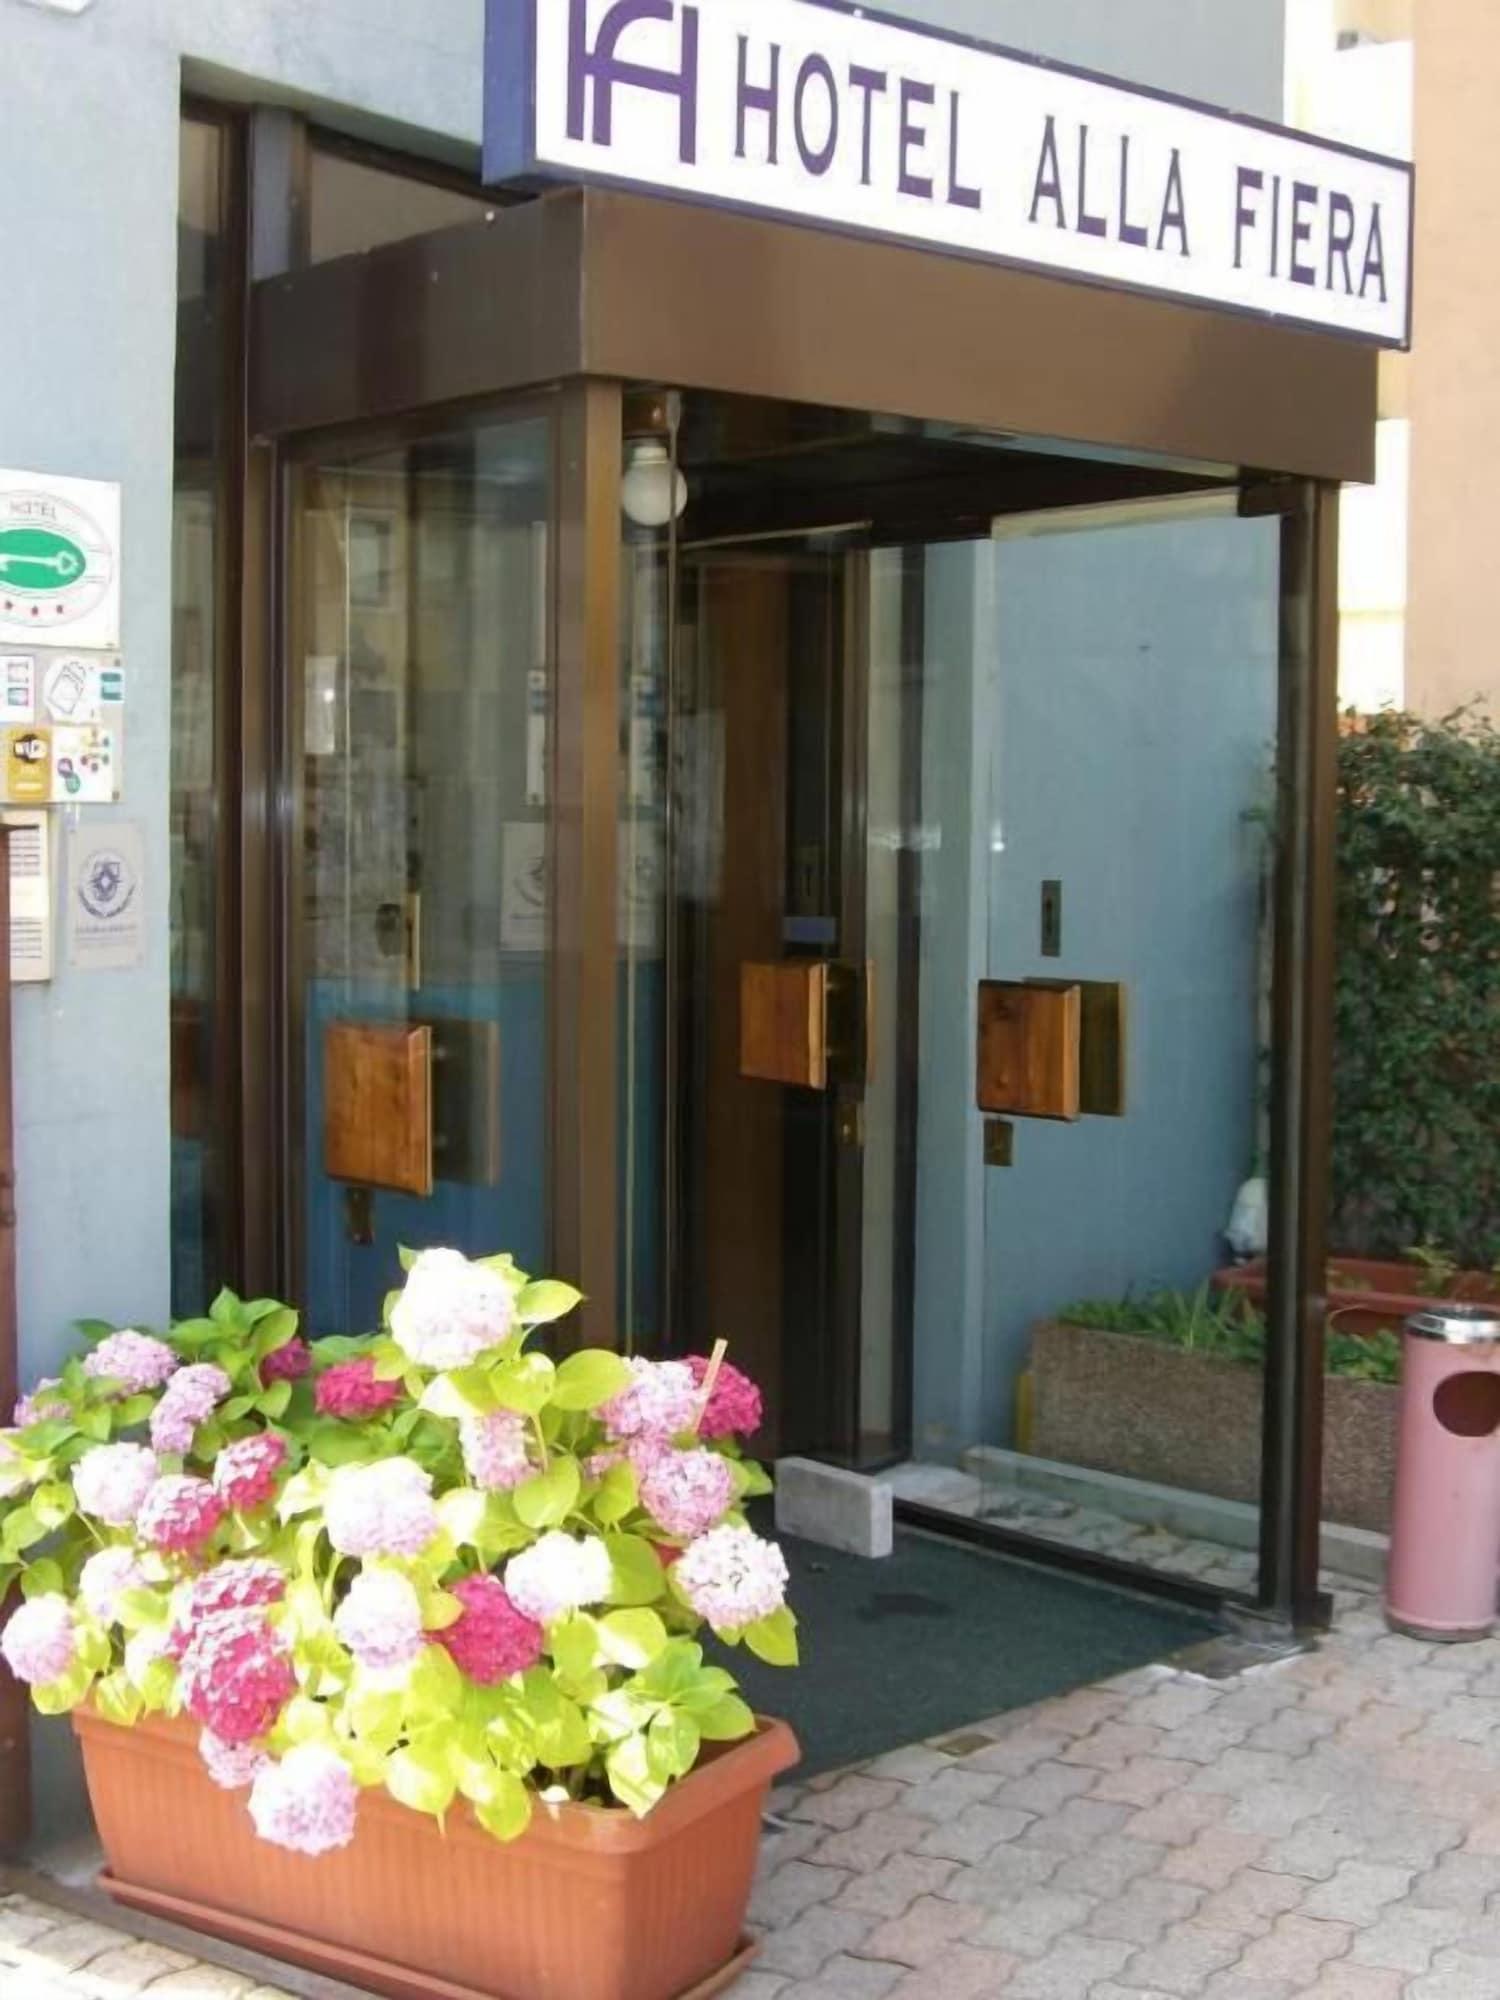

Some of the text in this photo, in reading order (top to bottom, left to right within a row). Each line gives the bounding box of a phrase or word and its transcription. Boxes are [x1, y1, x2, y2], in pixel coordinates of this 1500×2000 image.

[735, 35, 1387, 303] HOTEL ALLA FIERA
